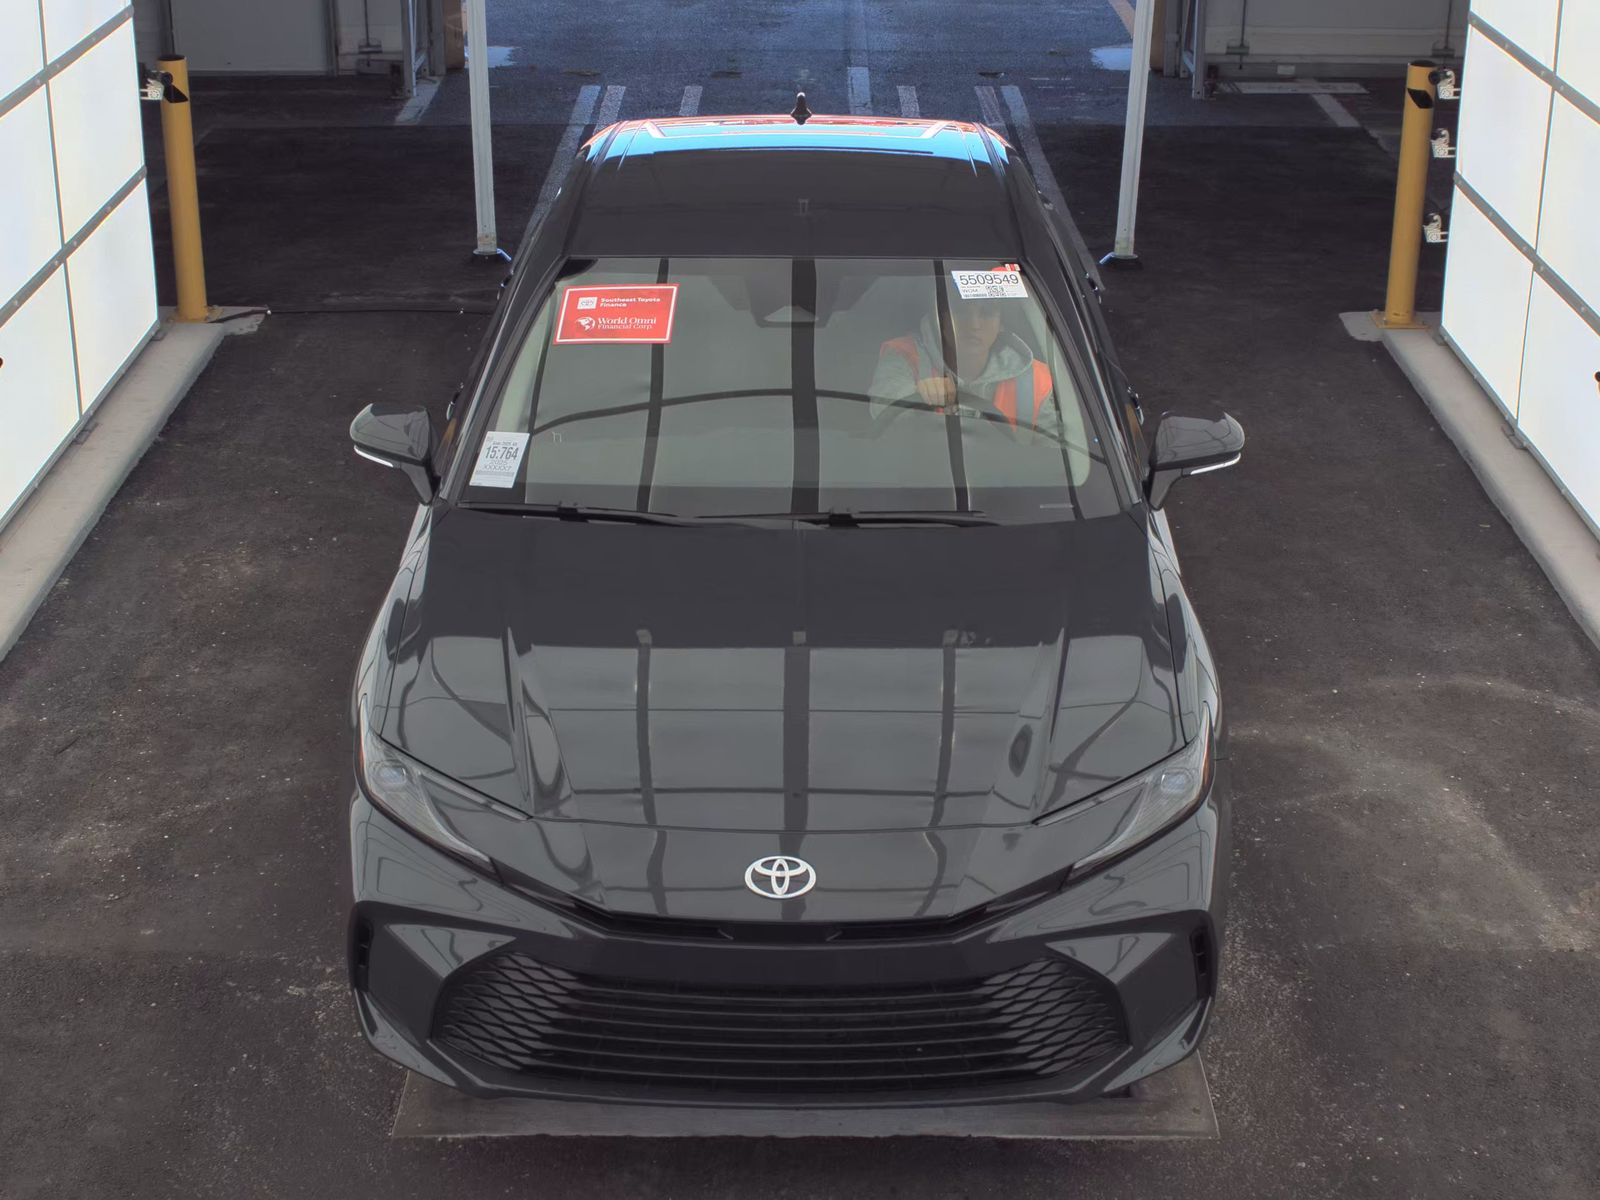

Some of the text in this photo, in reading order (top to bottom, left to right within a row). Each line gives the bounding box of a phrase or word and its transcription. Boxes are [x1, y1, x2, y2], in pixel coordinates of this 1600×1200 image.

[959, 274, 1019, 285] 5509549
[598, 317, 657, 325] World Omni
